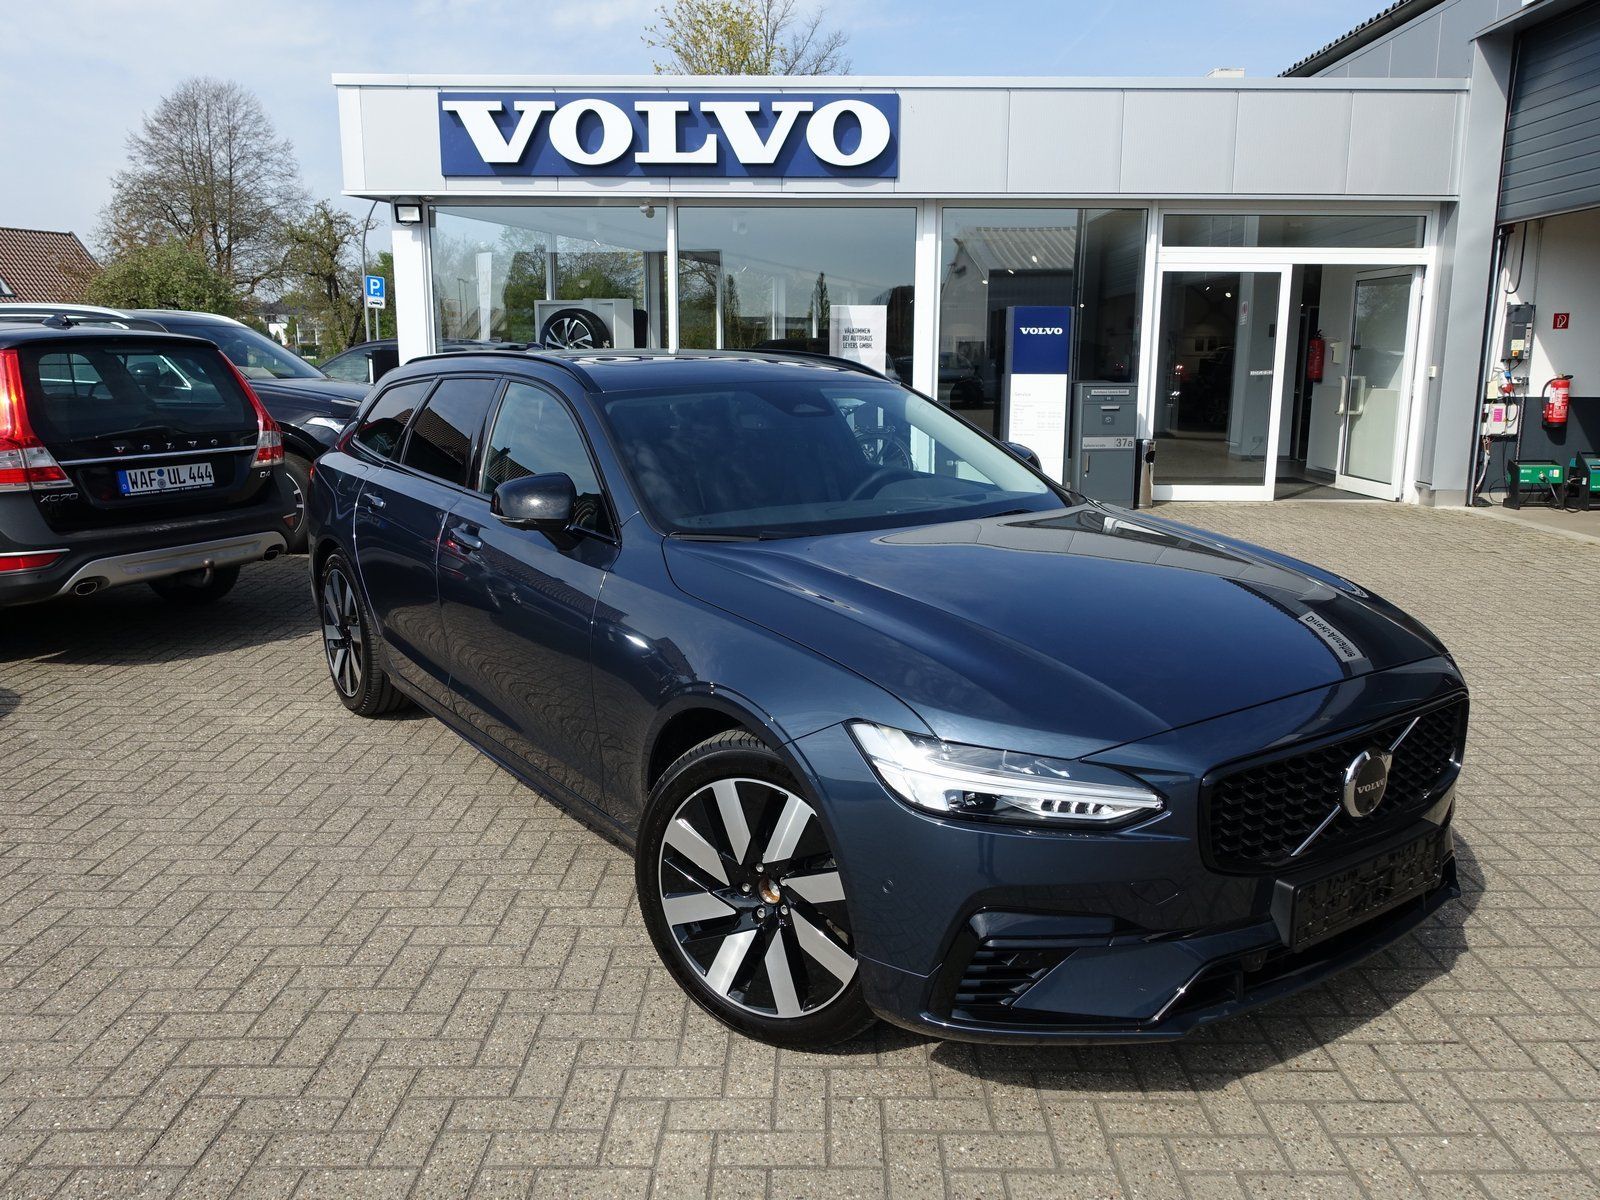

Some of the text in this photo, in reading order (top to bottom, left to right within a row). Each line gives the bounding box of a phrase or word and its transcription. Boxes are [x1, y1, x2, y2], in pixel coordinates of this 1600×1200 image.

[442, 98, 890, 166] VOLVO
[370, 278, 380, 295] P
[1020, 327, 1063, 335] VOLVO
[113, 439, 218, 454] VOLVO
[1116, 438, 1133, 448] 37a
[129, 470, 157, 490] WAF
[167, 467, 186, 485] UL
[189, 465, 212, 482] 444
[40, 492, 79, 503] XC70
